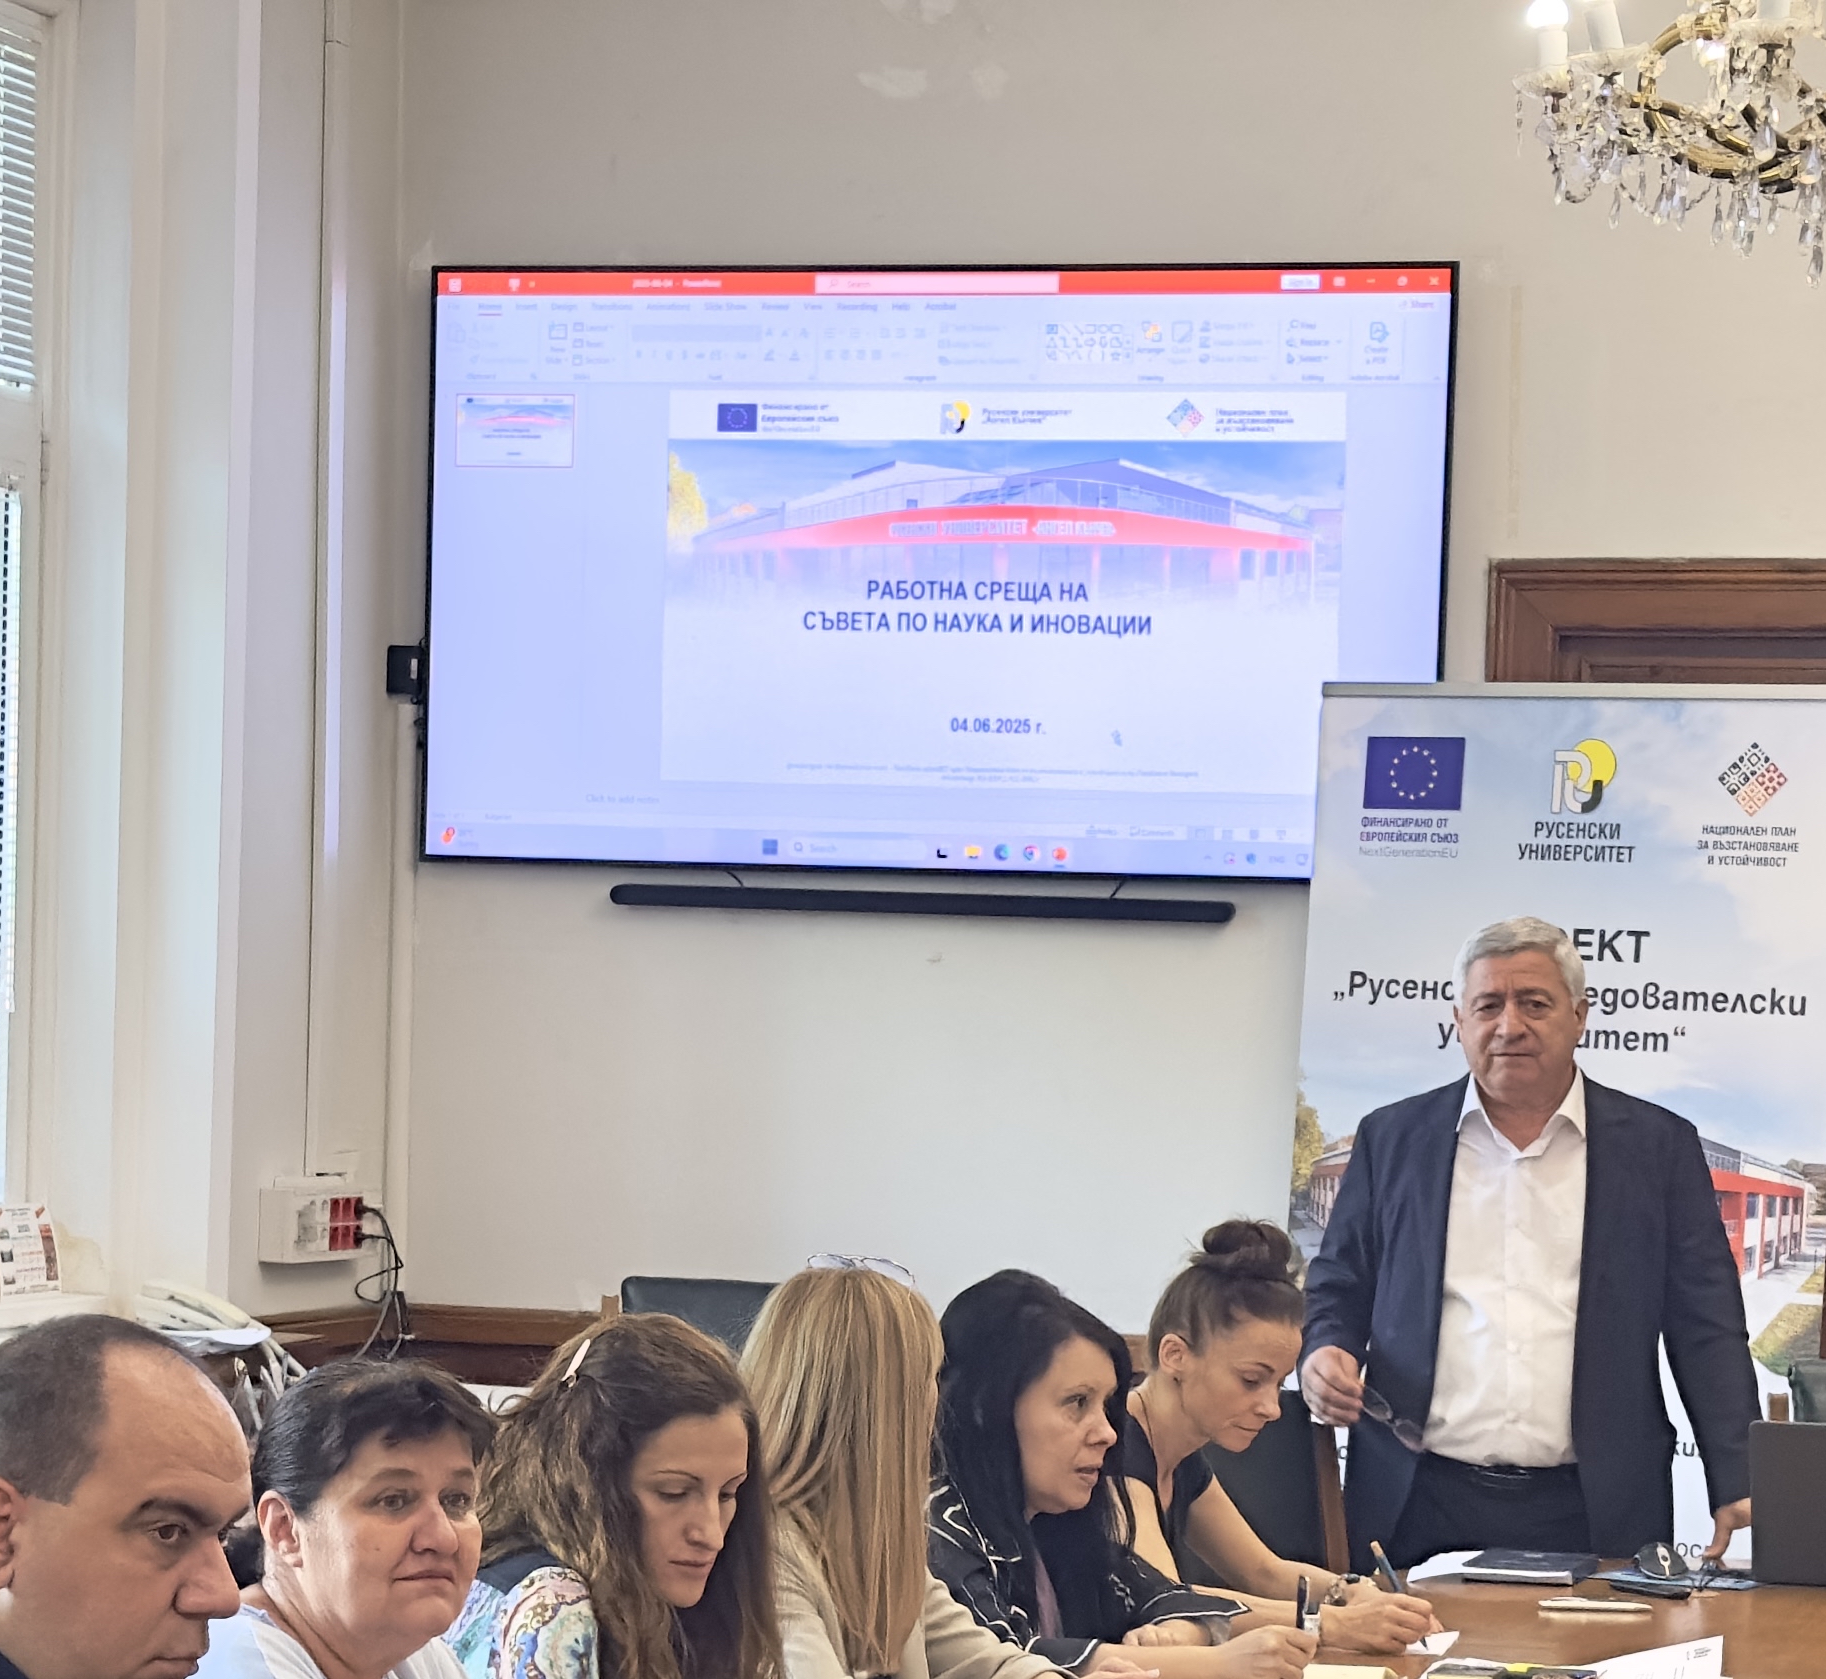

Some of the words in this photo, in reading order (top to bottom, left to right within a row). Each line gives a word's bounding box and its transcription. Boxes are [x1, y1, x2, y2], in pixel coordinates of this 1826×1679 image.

[867, 580, 968, 601] РАБОТНА
[974, 581, 1052, 605] СРЕЩА
[1059, 582, 1089, 602] НА
[803, 611, 890, 631] СЪВЕТА
[897, 612, 928, 632] ПО
[933, 612, 1003, 633] НАУКА
[1010, 613, 1024, 633] И
[1030, 614, 1152, 638] ИНОВАЦИИ
[950, 717, 1031, 734] 04.06.2025
[1035, 722, 1047, 735] г.
[1360, 816, 1433, 829] ФИНАНСИРАНО
[1436, 818, 1449, 829] ОТ
[1534, 821, 1621, 840] РУСЕНСКИ
[1702, 824, 1768, 837] НАЦИОНАЛЕН
[1771, 826, 1797, 837] ПЛАН
[1360, 830, 1428, 844] ЕВРОПЕЙСКИЯ
[1430, 832, 1459, 844] СЪЮЗ
[1359, 846, 1459, 859] NextGenerationEU
[1518, 843, 1636, 864] УНИВЕРСИТЕТ
[1697, 840, 1709, 850] ЗА
[1712, 840, 1800, 853] ВЪЗСТАНОВЯВАНЕ
[1707, 855, 1715, 865] И
[1718, 854, 1788, 868] УСТОЙЧИВОСТ
[1559, 927, 1651, 963] ЕКТ
[1333, 970, 1455, 1005] „Русенс
[1584, 981, 1807, 1017] едователски
